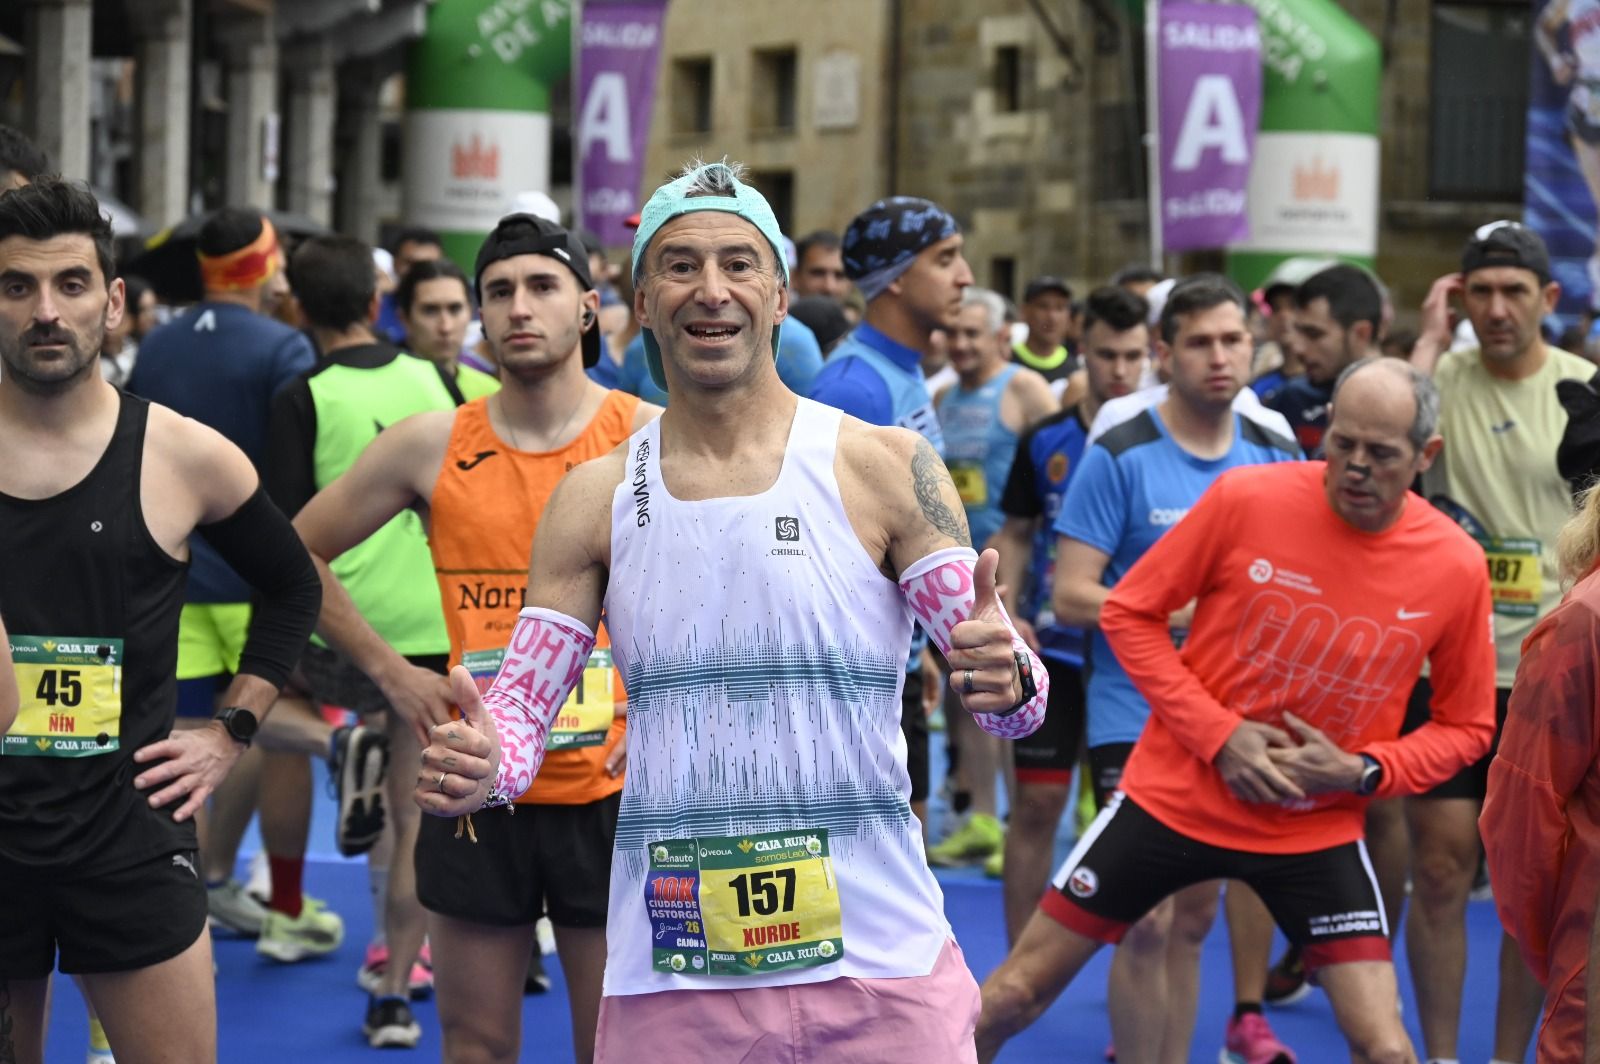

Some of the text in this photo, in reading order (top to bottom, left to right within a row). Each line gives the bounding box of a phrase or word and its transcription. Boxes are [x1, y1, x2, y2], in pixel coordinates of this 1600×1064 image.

[1165, 22, 1260, 51] SALIDA
[581, 72, 634, 162] A
[1172, 74, 1249, 171] A
[632, 462, 651, 528] MOVING
[771, 548, 807, 557] CHIHILL
[56, 643, 82, 654] CAJA
[83, 644, 117, 655] RUL
[35, 669, 82, 707] 45
[49, 712, 75, 733] ÑÍN
[54, 740, 79, 750] CAJA
[708, 848, 733, 856] VEOLIA
[754, 838, 783, 852] CAJA
[651, 876, 696, 902] 10K
[728, 867, 797, 917] 157
[648, 899, 698, 909] CIUDAD DE
[651, 909, 701, 920] ASTORGA
[684, 920, 700, 934] 26
[742, 922, 801, 948] XURDE
[676, 937, 699, 948] CAJÓN
[766, 950, 796, 963] CAJA
